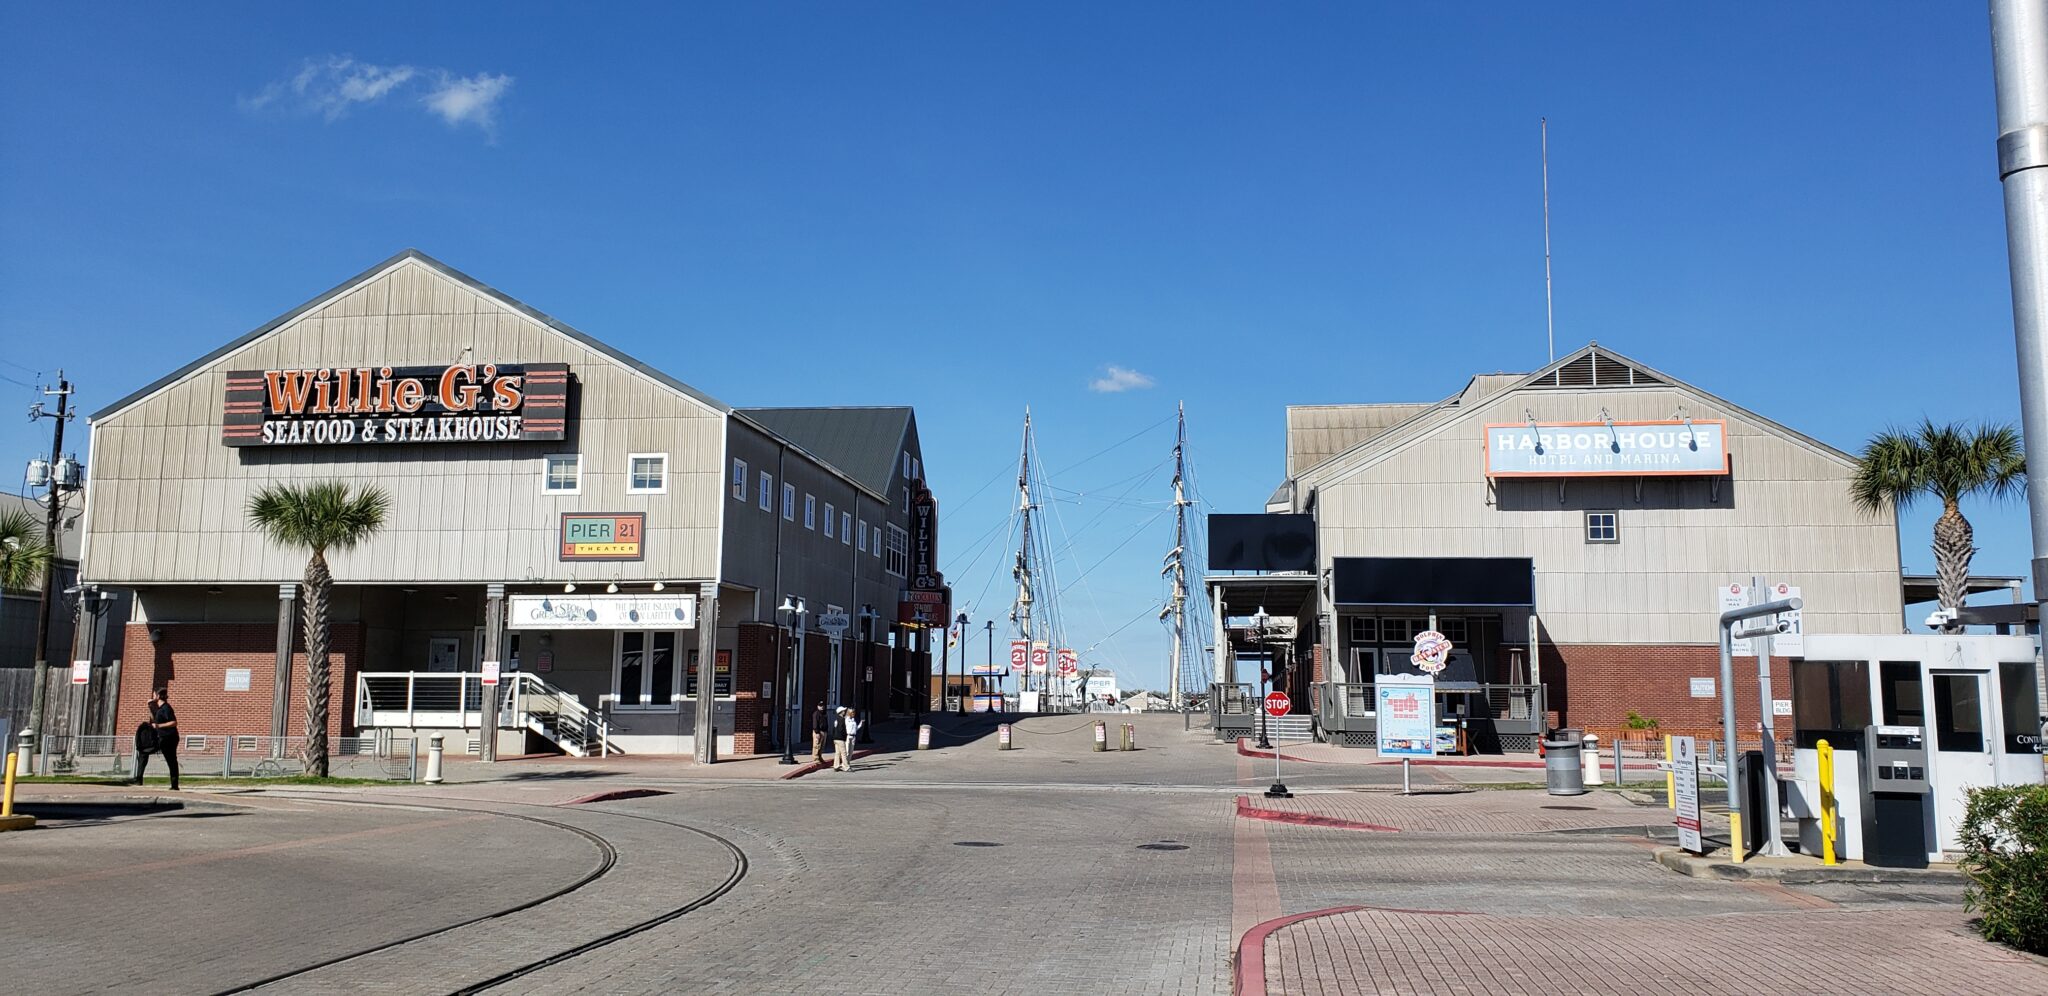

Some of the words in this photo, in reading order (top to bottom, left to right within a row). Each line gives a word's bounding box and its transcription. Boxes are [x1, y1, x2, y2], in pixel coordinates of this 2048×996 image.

[264, 366, 425, 415] Willie
[440, 362, 524, 412] G's
[262, 418, 356, 444] SEAFOOD
[361, 419, 378, 443] &
[384, 415, 522, 442] STEAKHOUSE
[1497, 432, 1610, 451] HARBOR
[1619, 431, 1712, 449] HOUSE
[1529, 454, 1577, 465] HOTEL
[1584, 454, 1613, 465] AND
[1620, 452, 1681, 465] MARINA
[571, 523, 610, 538] PIER
[619, 523, 635, 537] 21
[917, 505, 931, 575] WILLIE
[915, 575, 936, 589] G's
[615, 602, 627, 611] THE
[653, 602, 679, 611] ISLAND
[619, 611, 627, 620] OF
[1416, 632, 1444, 641] DOLPHIN
[718, 655, 727, 663] 21
[1012, 652, 1026, 662] 21
[1033, 652, 1047, 662] 21
[1421, 663, 1444, 671] TOURS
[1265, 699, 1289, 709] STOP
